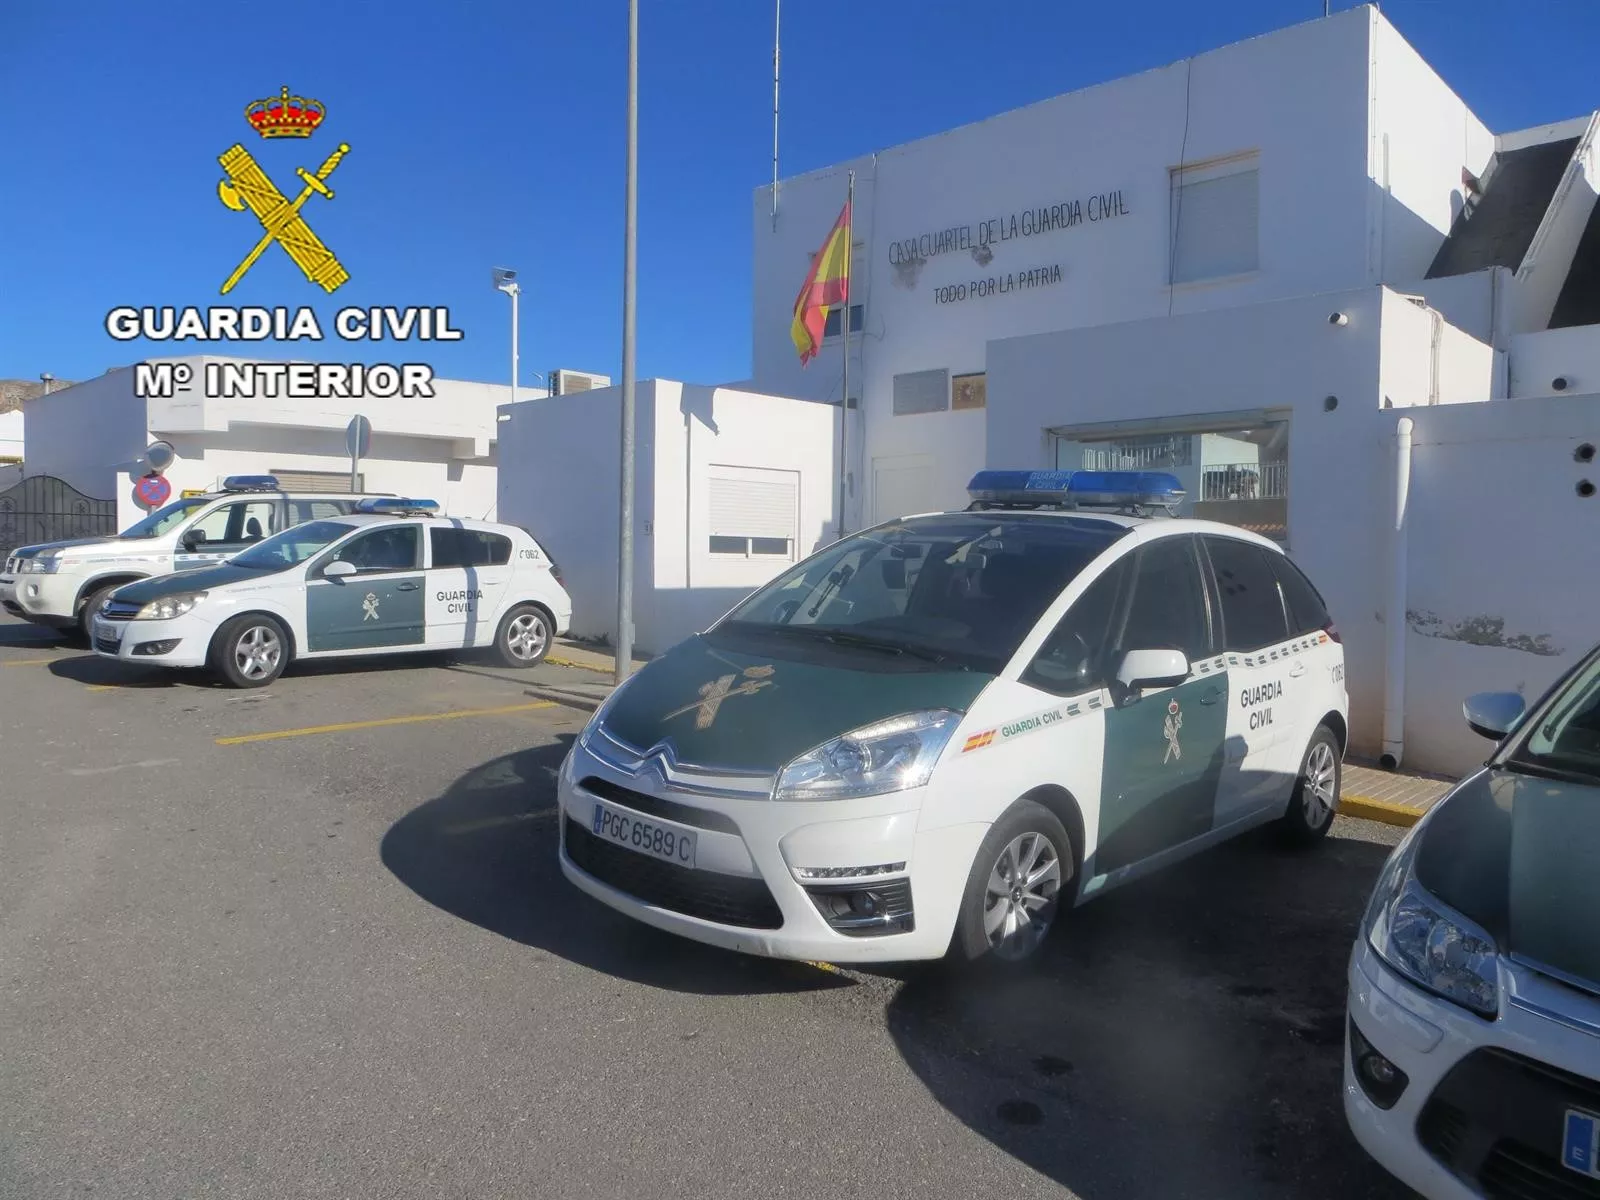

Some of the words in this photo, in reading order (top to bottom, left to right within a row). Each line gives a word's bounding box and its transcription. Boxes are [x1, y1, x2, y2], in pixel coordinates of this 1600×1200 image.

[979, 219, 998, 246] DE
[1001, 214, 1018, 241] LA
[1021, 200, 1082, 237] GUARDIA
[1087, 190, 1130, 222] CIVIL
[934, 284, 966, 305] TODO
[970, 278, 996, 299] POR
[999, 273, 1014, 293] LA
[1018, 264, 1062, 290] PATRIA
[436, 589, 484, 602] GUARDIA
[447, 602, 474, 614] CIVIL
[1240, 680, 1283, 708] GUARDIA
[1002, 717, 1042, 738] GUARDIA
[1042, 709, 1063, 724] CIVIL
[1249, 707, 1273, 731] CIVIL
[602, 811, 630, 842] PGC
[631, 821, 676, 857] 6589
[678, 836, 691, 862] C
